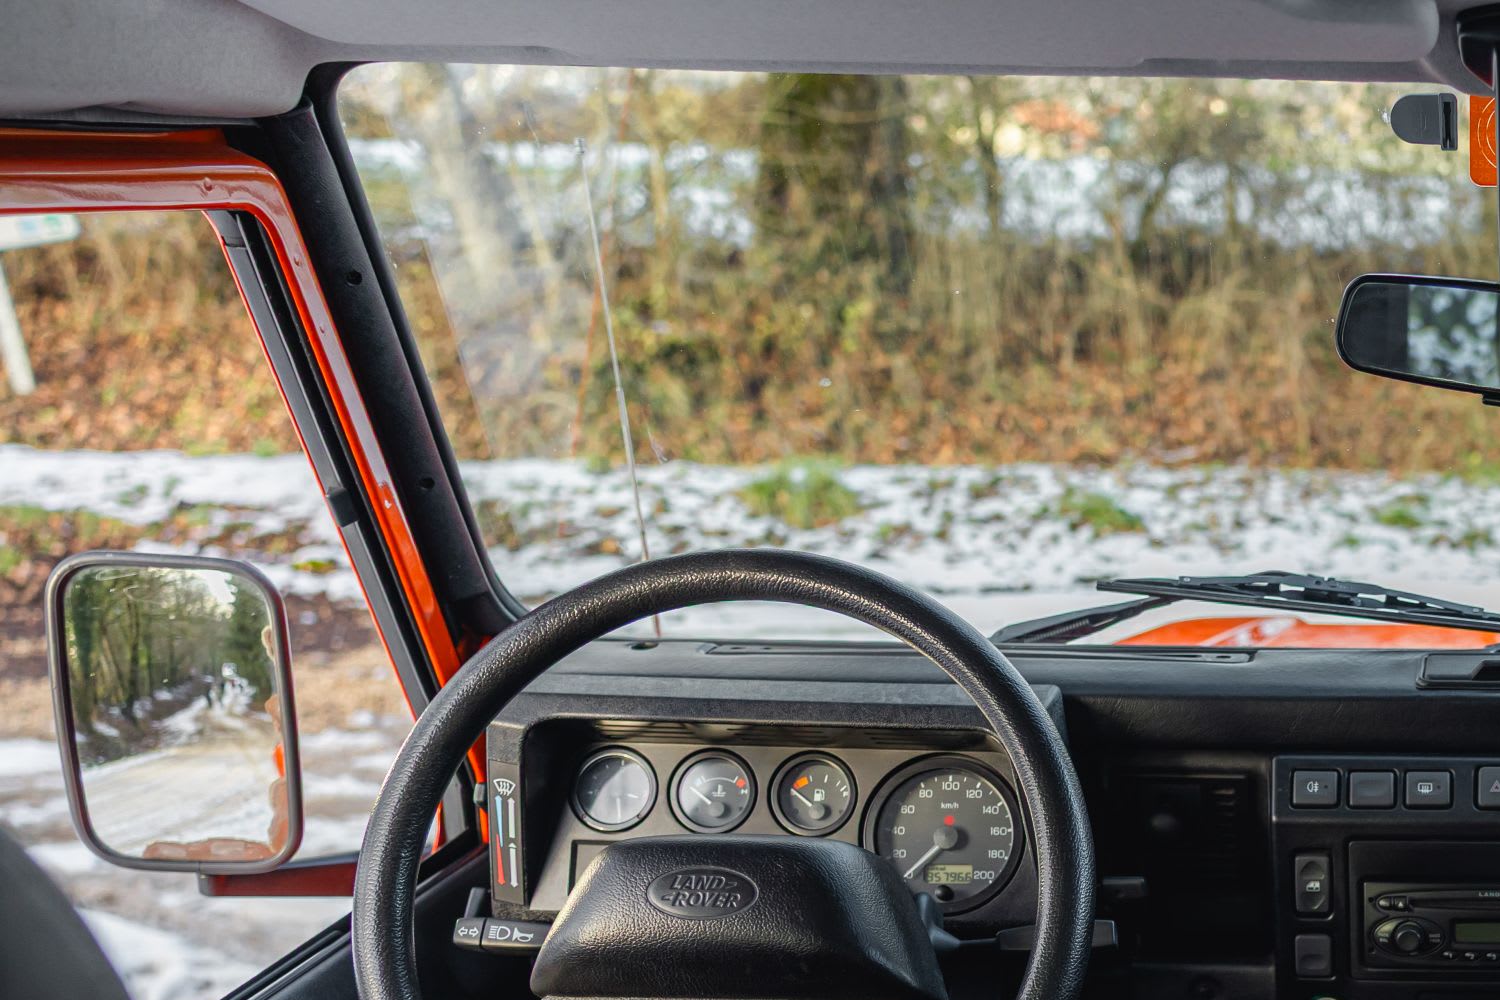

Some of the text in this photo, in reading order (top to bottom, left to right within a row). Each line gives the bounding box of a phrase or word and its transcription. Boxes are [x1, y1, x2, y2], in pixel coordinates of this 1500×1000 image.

[942, 781, 960, 790] 100
[918, 789, 933, 798] 80
[966, 789, 983, 799] 120
[900, 804, 915, 815] 60
[940, 802, 959, 810] km/h
[982, 805, 999, 815] 140
[990, 826, 1007, 836] 160
[892, 849, 906, 858] 20
[988, 849, 1005, 859] 180
[973, 870, 995, 880] 200
[671, 875, 726, 890] LAND
[672, 891, 741, 908] ROVER
